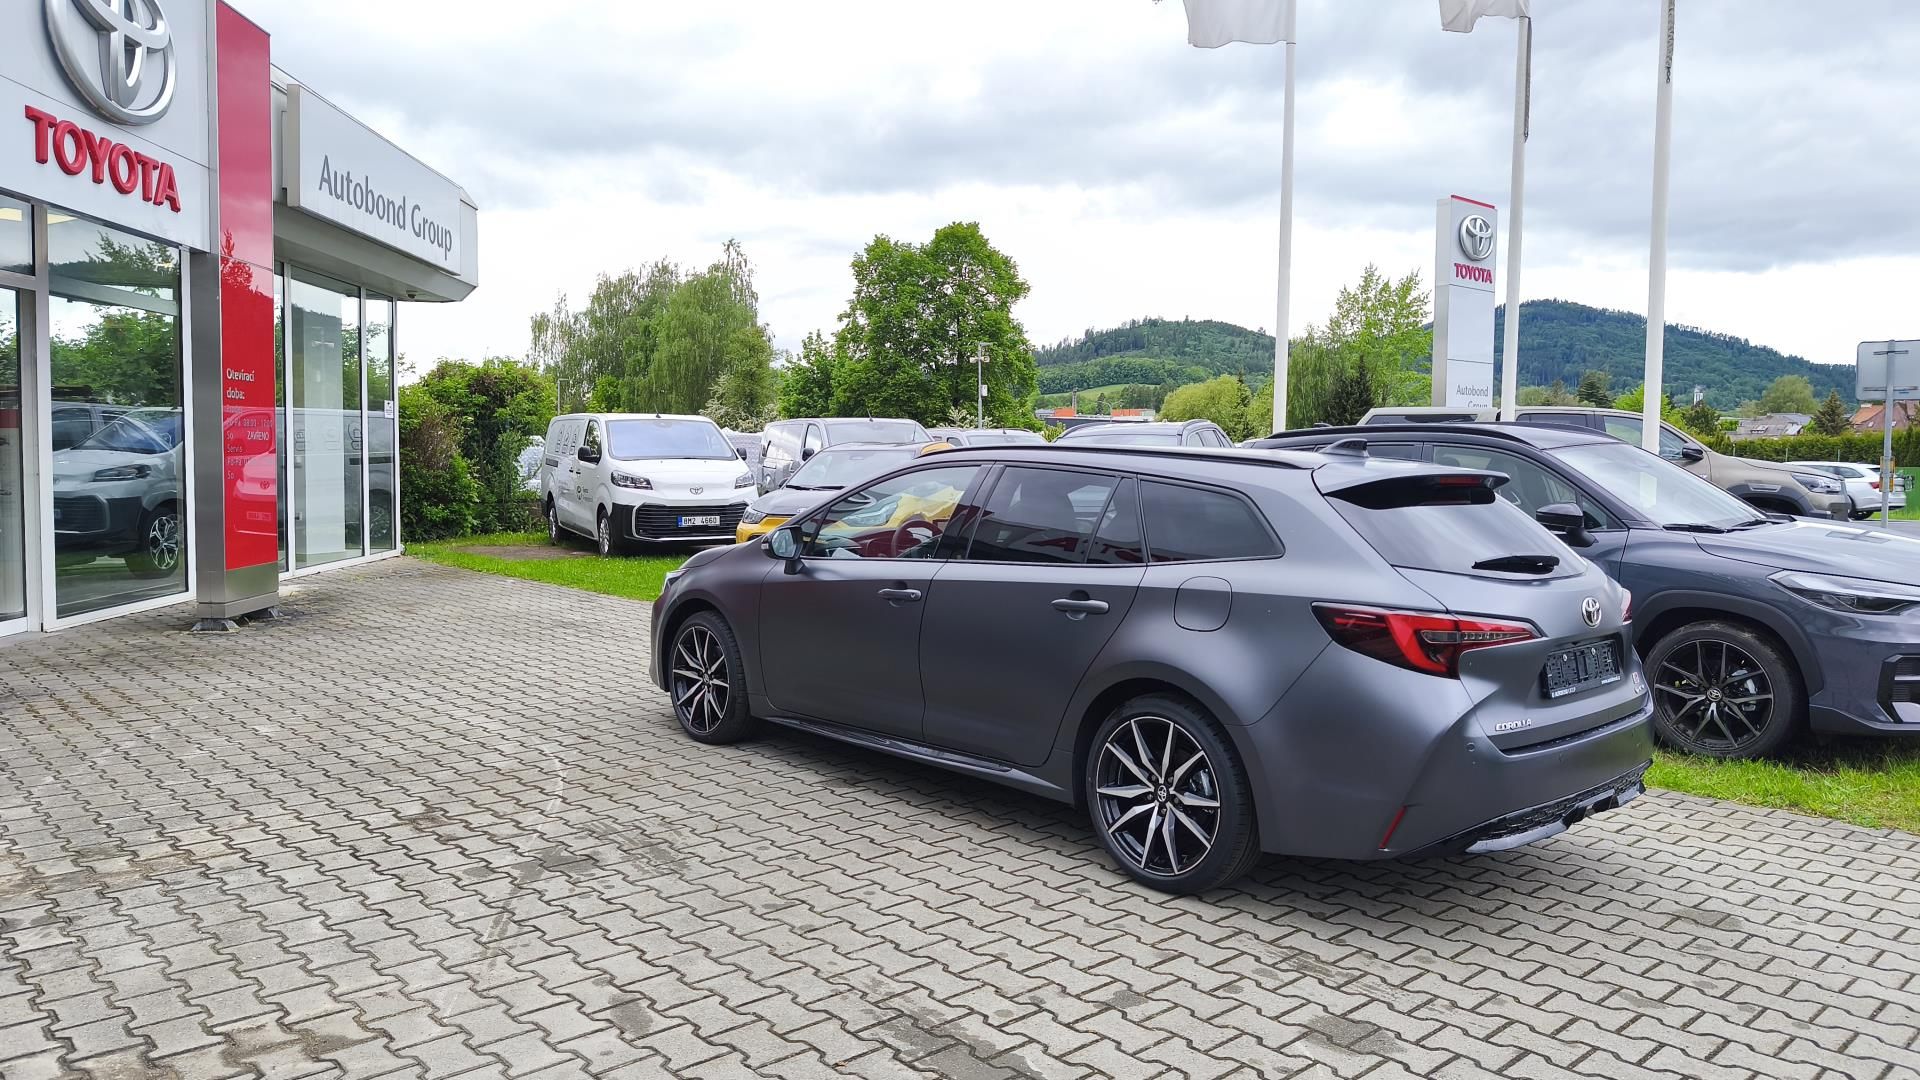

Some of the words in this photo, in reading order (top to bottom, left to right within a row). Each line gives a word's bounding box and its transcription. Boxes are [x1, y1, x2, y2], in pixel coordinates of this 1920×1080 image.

[25, 104, 181, 213] TOYOTA
[319, 154, 406, 230] Autobond
[411, 204, 452, 261] Group
[1454, 262, 1493, 284] TOYOTA
[226, 368, 255, 382] Otevírací
[226, 386, 245, 400] doba:
[1456, 384, 1489, 397] Autobond
[700, 516, 717, 524] 4660
[1495, 718, 1532, 731] COROLLA
